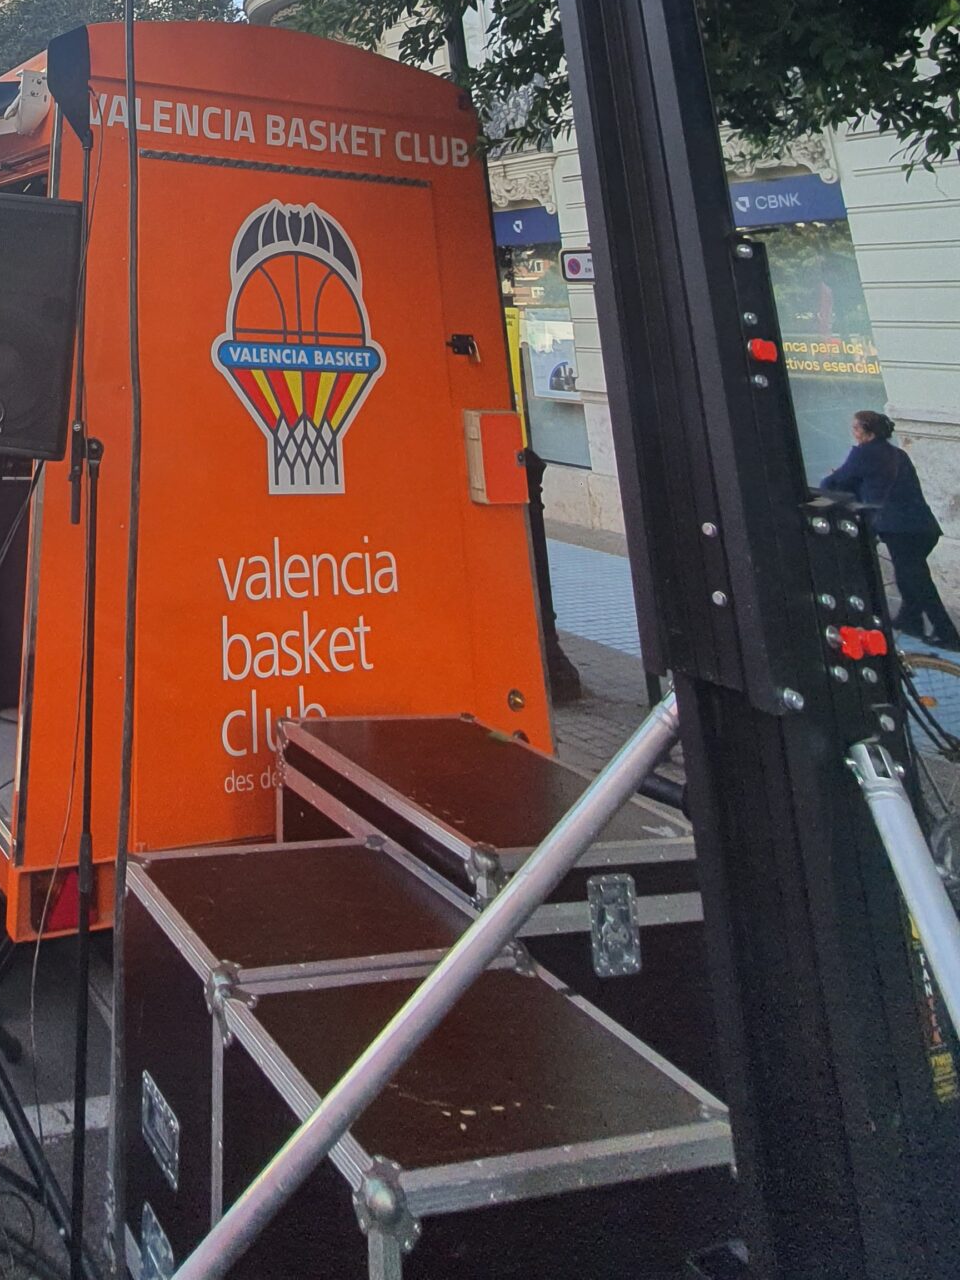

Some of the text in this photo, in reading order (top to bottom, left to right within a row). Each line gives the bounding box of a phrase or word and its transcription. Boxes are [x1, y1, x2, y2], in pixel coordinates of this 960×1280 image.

[89, 93, 470, 168] VALENCIA BASKET CLUB
[754, 192, 801, 210] CBNK
[229, 347, 371, 368] VALENCIA BASKET
[783, 341, 863, 356] nca para los
[823, 360, 882, 375] esencial
[218, 536, 399, 601] valencia
[222, 611, 374, 681] basket
[224, 768, 255, 793] des
